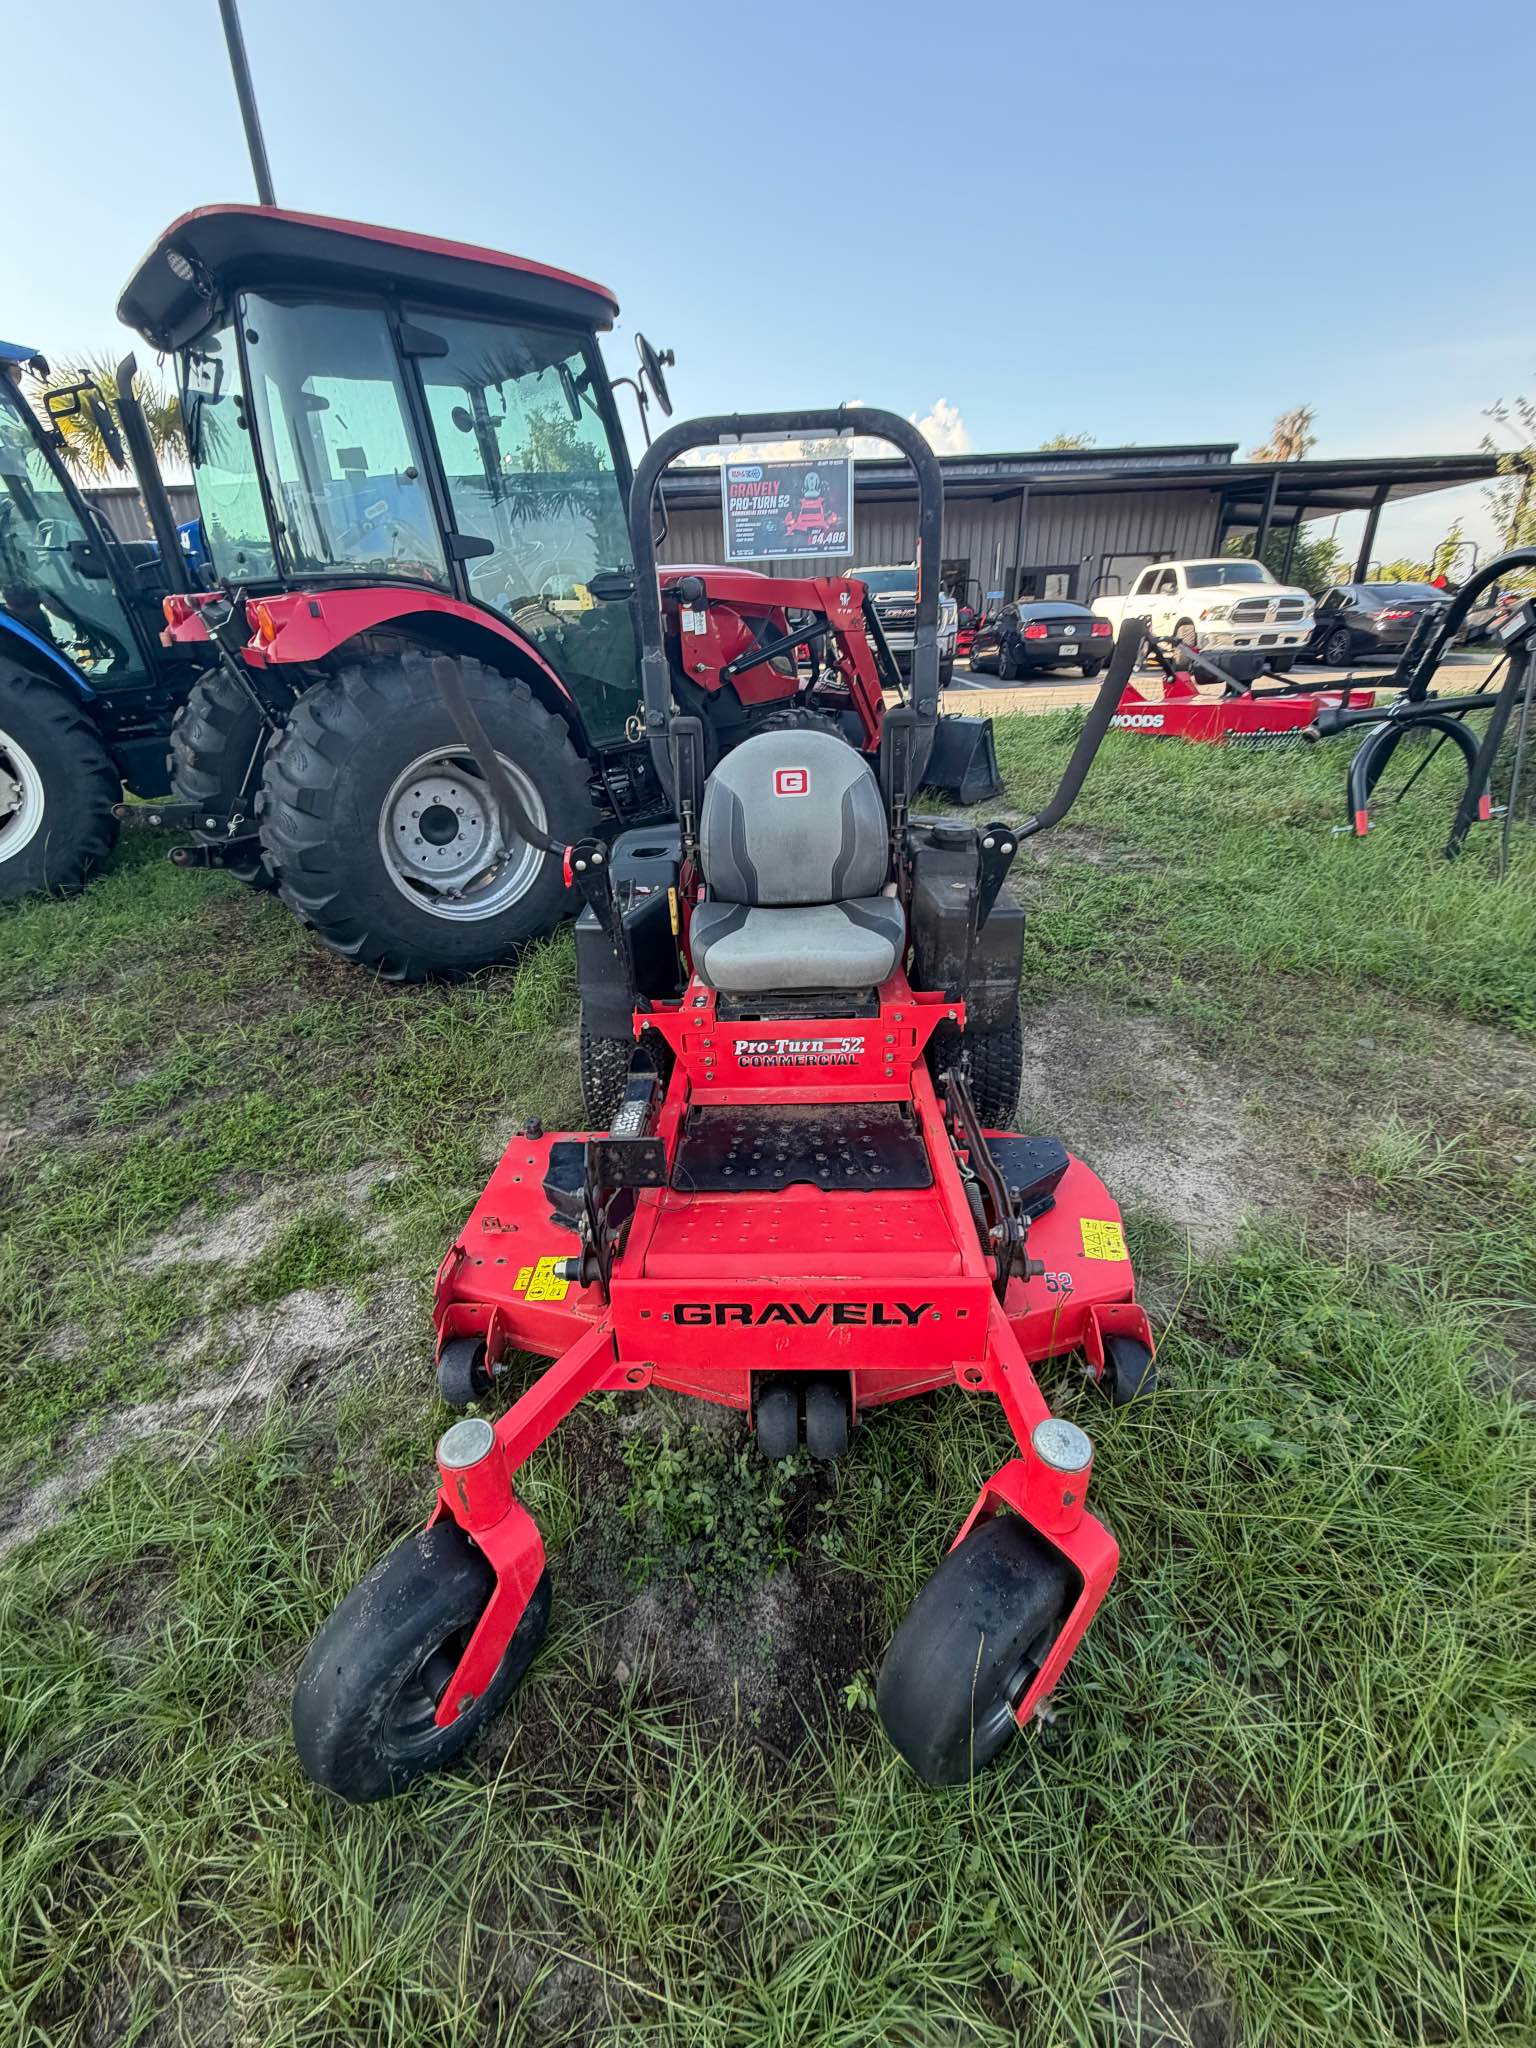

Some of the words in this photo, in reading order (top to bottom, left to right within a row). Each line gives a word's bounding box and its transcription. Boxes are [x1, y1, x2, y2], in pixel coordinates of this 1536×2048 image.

[730, 480, 780, 497] GRAVELY
[730, 496, 777, 511] PRO-TURN
[778, 495, 790, 508] 52
[1108, 715, 1165, 728] WOODS
[779, 771, 805, 793] G
[734, 1039, 824, 1056] Pro-Turn
[840, 1037, 863, 1053] 52
[738, 1053, 860, 1068] COMMERCIAL
[1044, 1272, 1073, 1293] 52
[673, 1303, 936, 1327] GRAVELY
